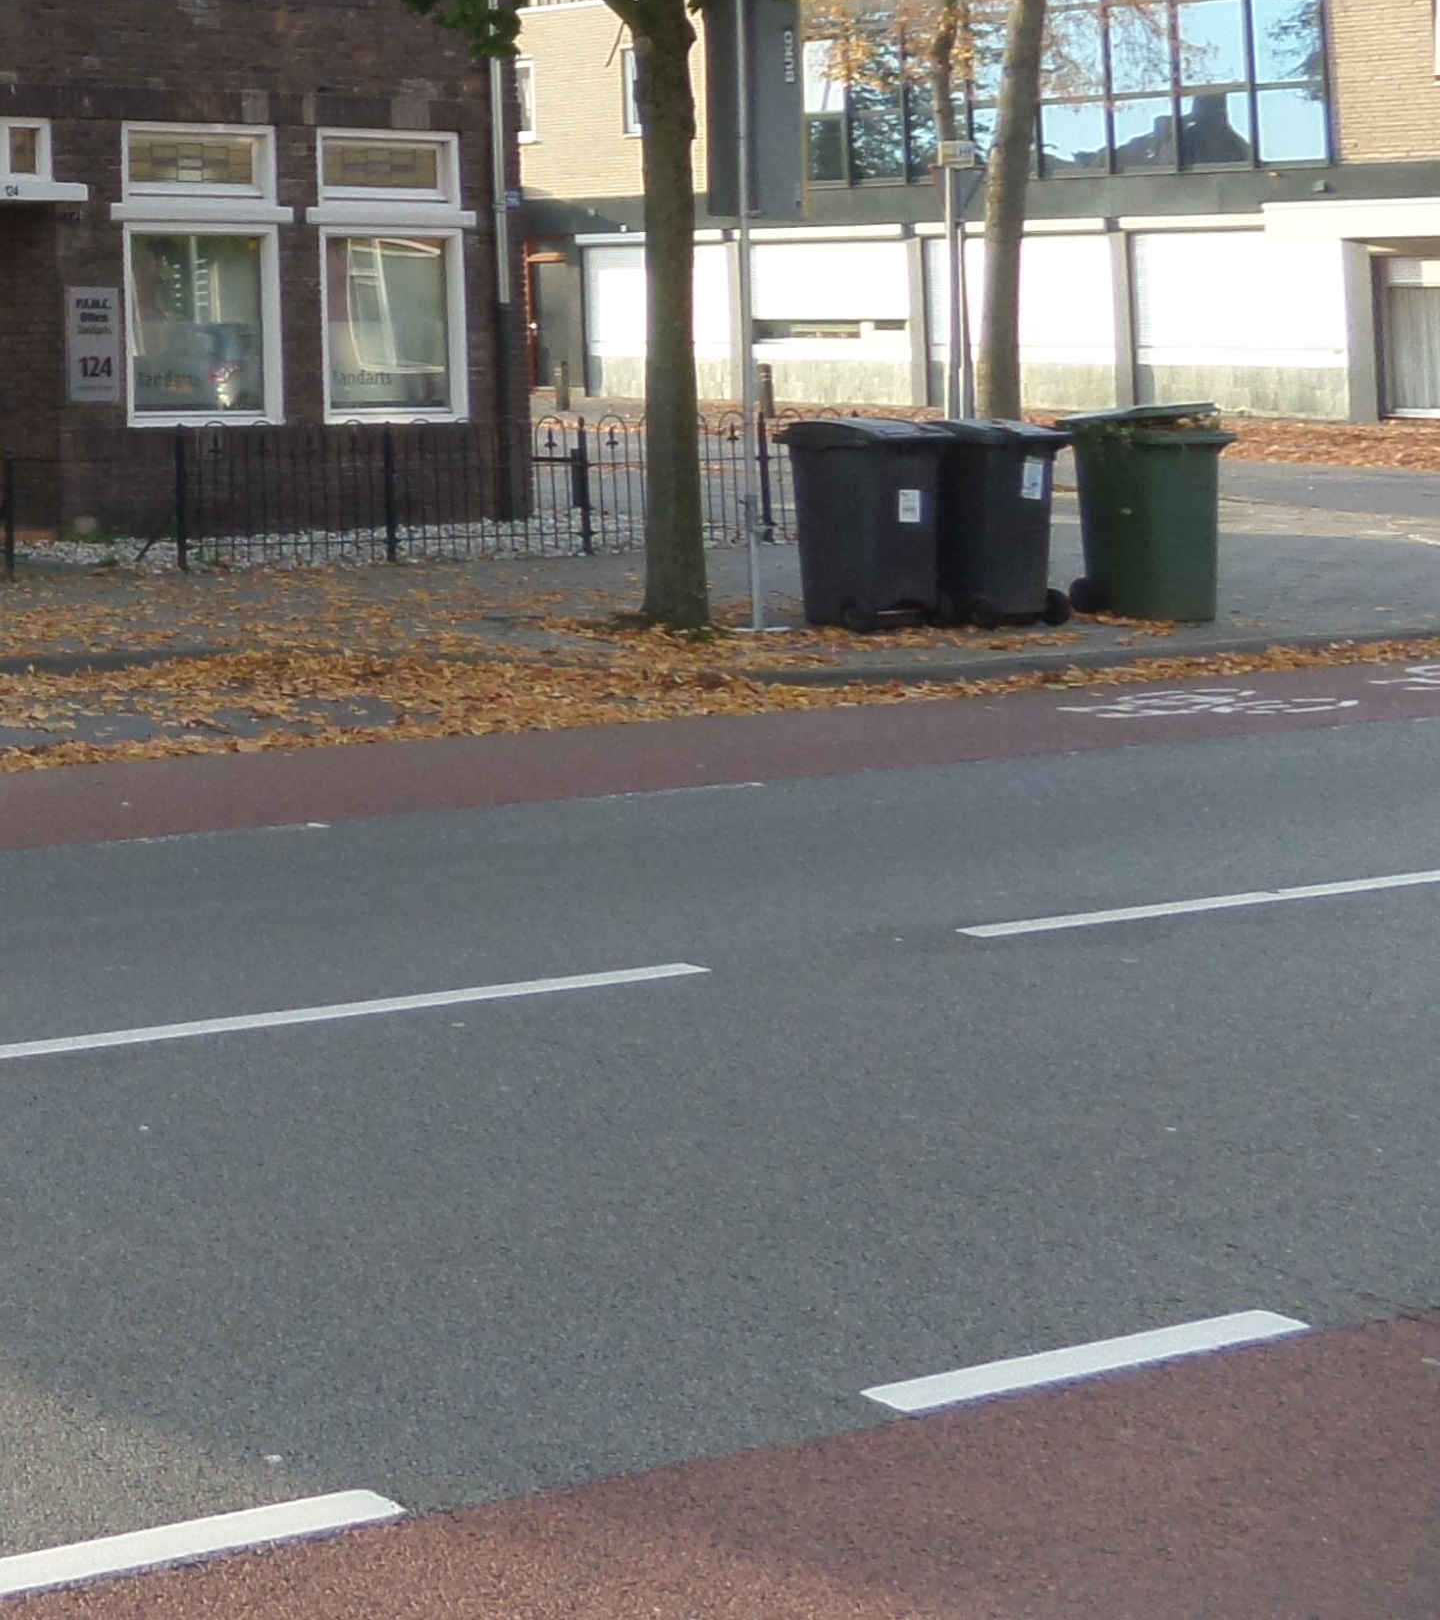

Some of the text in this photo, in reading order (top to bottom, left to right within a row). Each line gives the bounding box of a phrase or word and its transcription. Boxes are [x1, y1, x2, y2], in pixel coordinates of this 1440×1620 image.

[784, 31, 794, 82] BUKO
[5, 185, 18, 196] 124
[79, 356, 112, 377] 124
